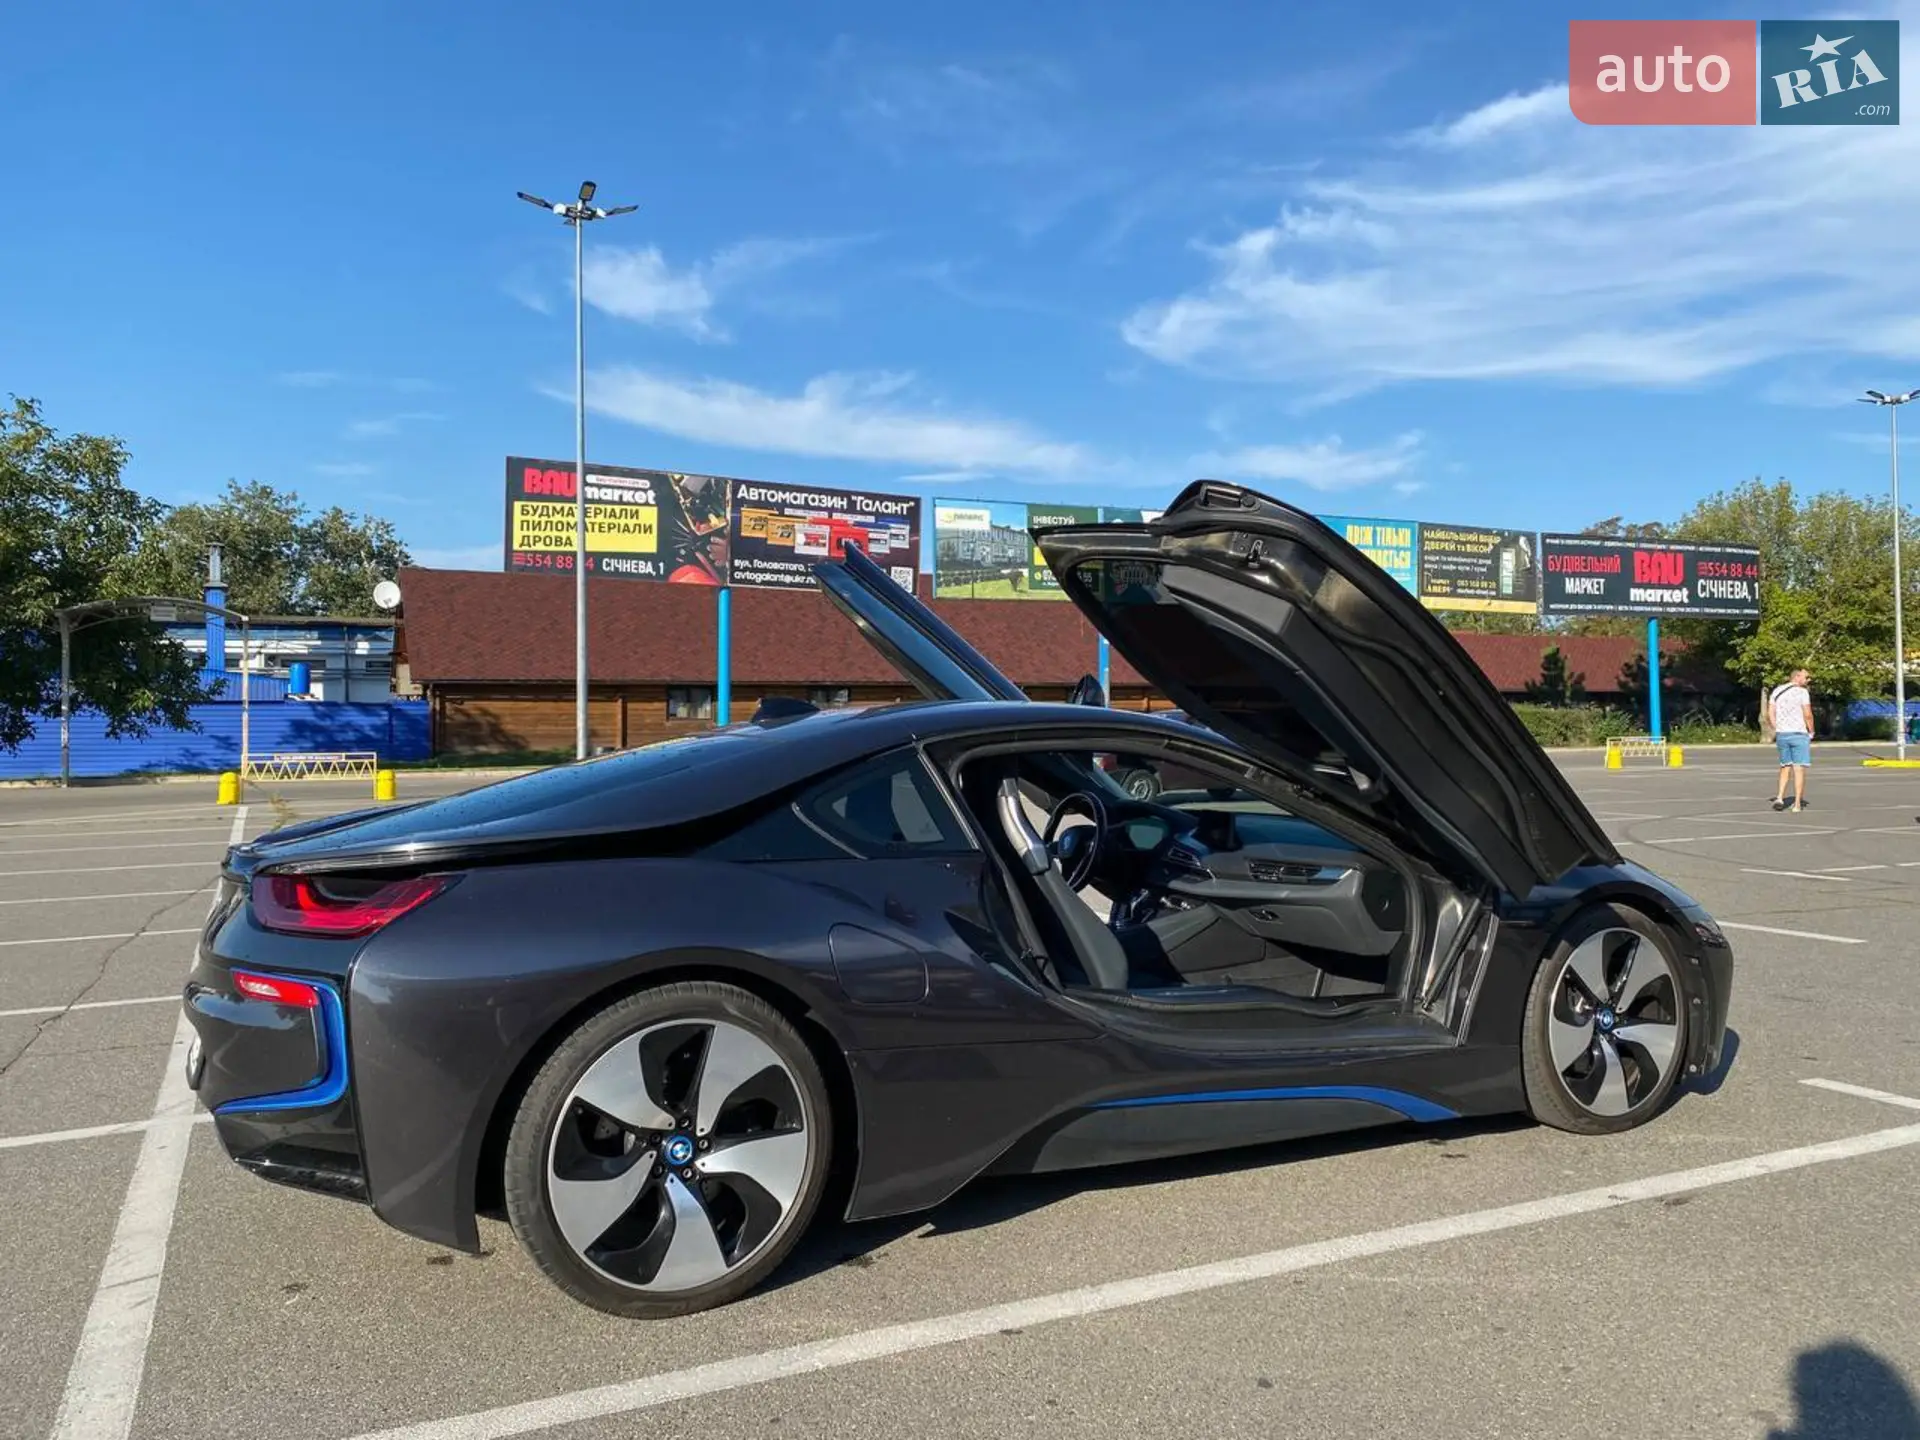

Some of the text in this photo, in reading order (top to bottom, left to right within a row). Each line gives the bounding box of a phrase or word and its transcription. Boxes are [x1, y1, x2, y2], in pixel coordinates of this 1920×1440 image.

[524, 467, 577, 497] BAU
[737, 484, 847, 509] Автомагазин
[520, 504, 640, 520] БУДМАЕРІАЛИ
[1033, 515, 1075, 525] ІНВЕСТУЙ
[519, 534, 573, 548] ДРОВА
[527, 552, 552, 567] 554
[556, 555, 574, 569] 88
[602, 557, 656, 576] СІЧНЕВА,
[1547, 554, 1621, 573] БУДІВЕЛЬНИЙ
[1633, 551, 1685, 585] BAU
[1708, 561, 1759, 578] 554 88 44
[1565, 577, 1606, 594] МАРКЕТ
[1697, 578, 1752, 602] СІЧНЕВА,
[1630, 587, 1690, 603] market
